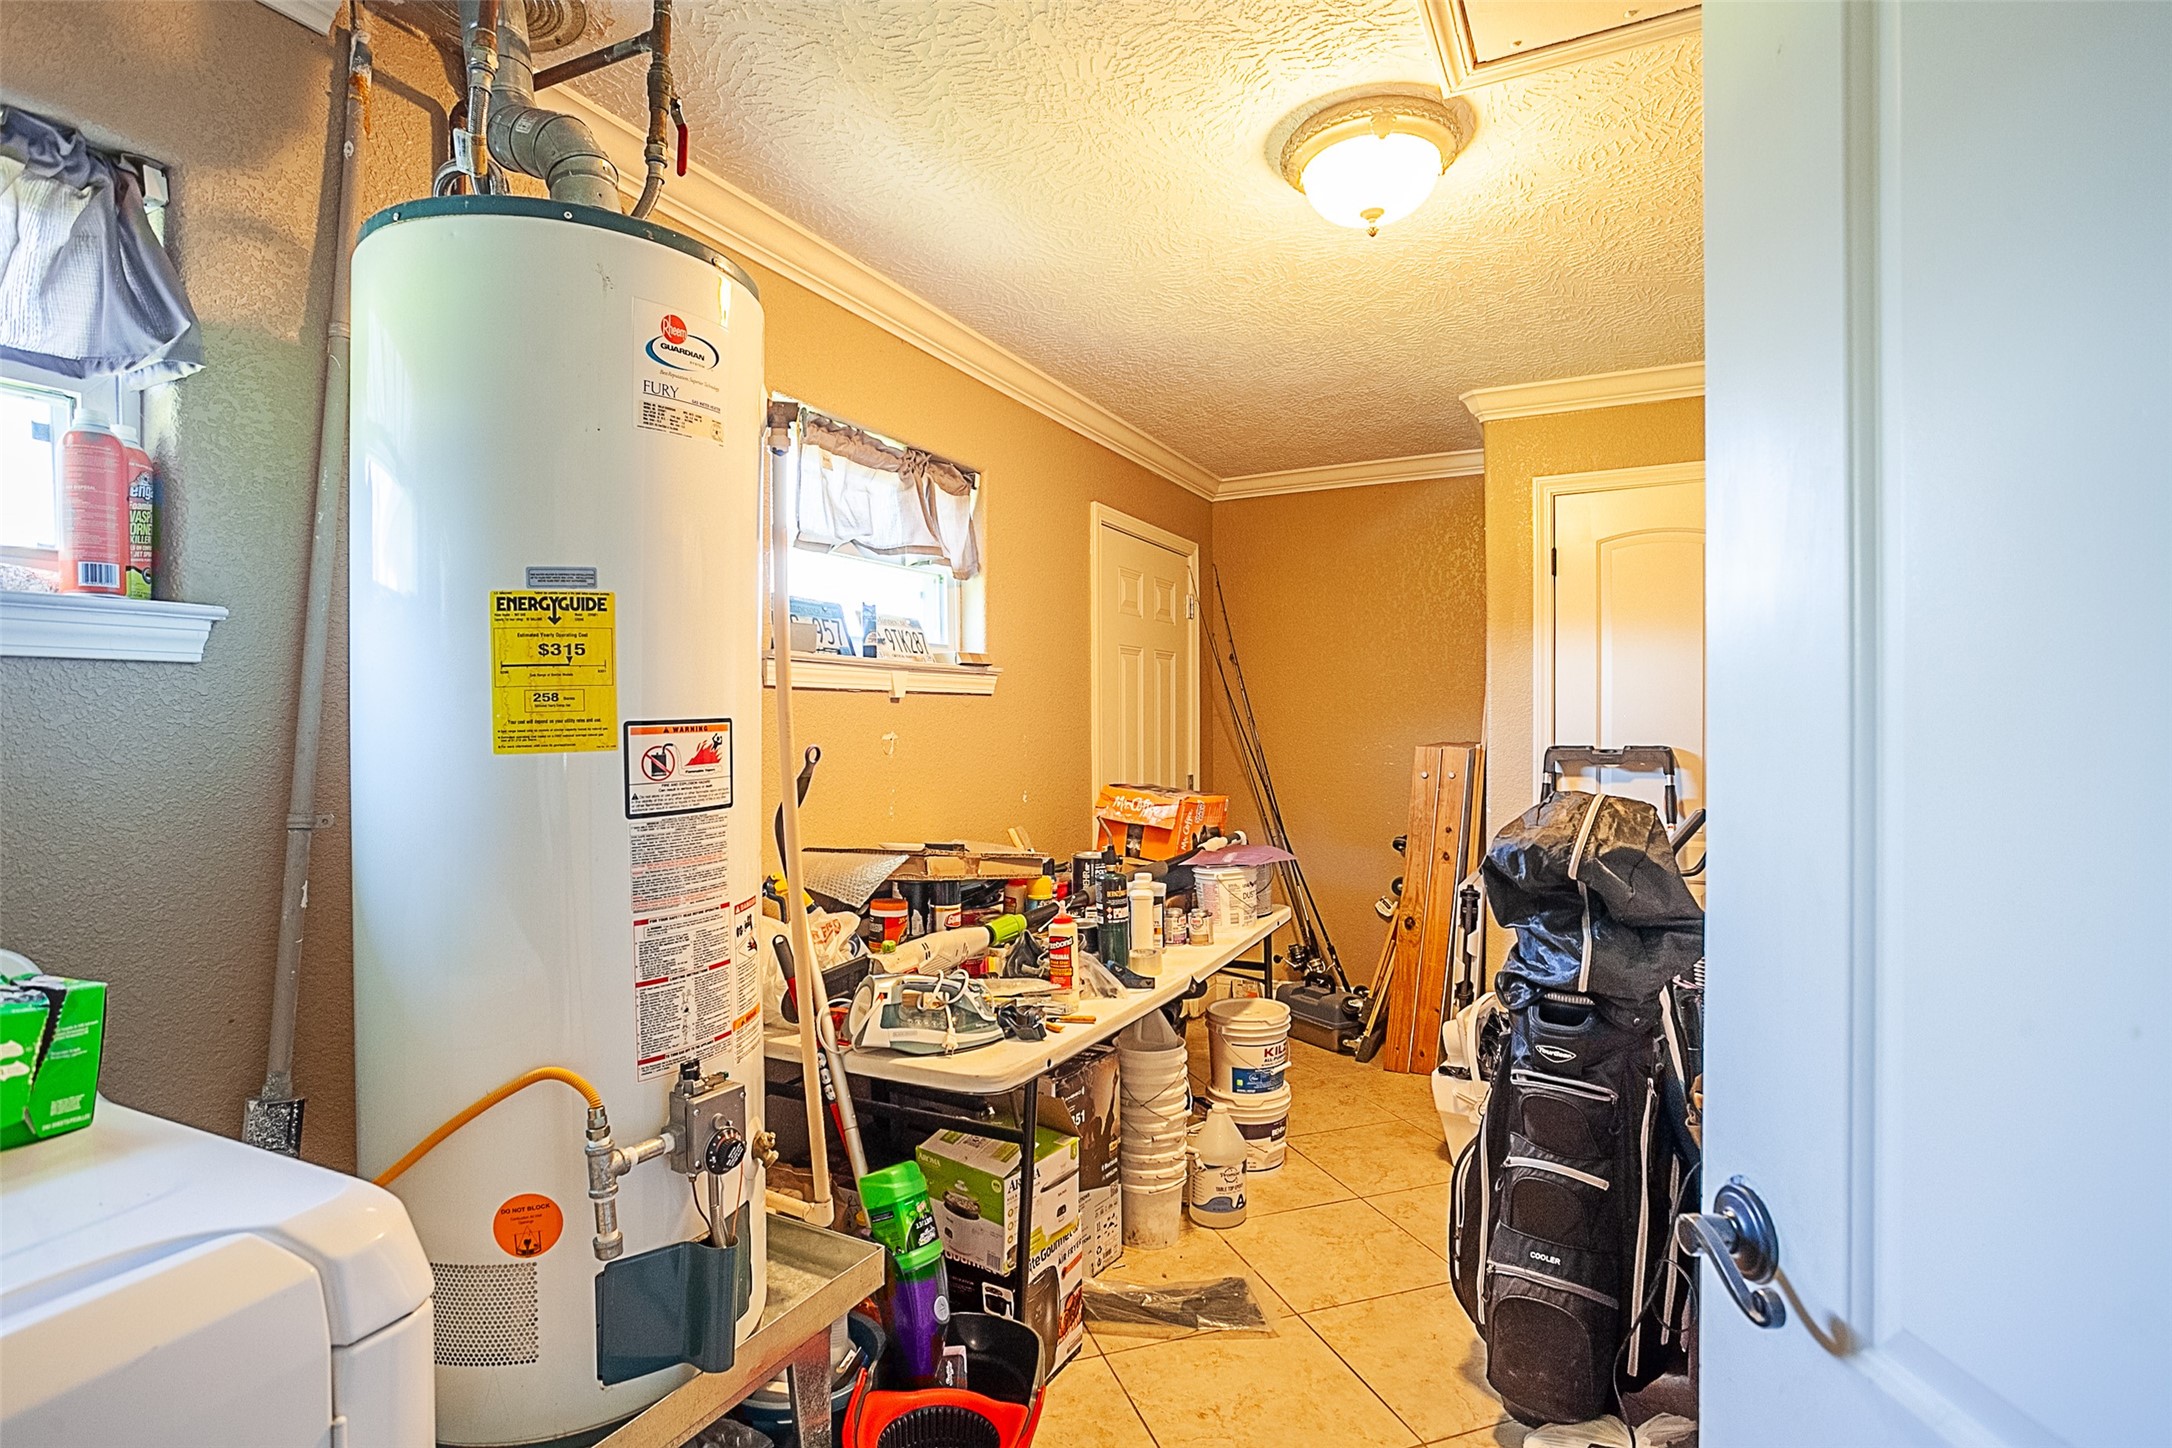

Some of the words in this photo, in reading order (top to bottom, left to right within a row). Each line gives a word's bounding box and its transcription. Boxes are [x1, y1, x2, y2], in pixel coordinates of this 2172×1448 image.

[662, 314, 688, 341] Rheem
[660, 342, 705, 361] GUARDIAN
[643, 379, 679, 398] FURY
[496, 596, 608, 612] ENERGYGUIDE
[884, 628, 929, 655] 9TK287
[538, 643, 586, 657] $315
[533, 692, 559, 703] 258
[672, 726, 709, 734] WARNING
[918, 1152, 940, 1167] AROMA
[512, 1206, 525, 1214] NOT
[527, 1203, 550, 1212] BLOCK
[1530, 1251, 1561, 1266] COOLER
